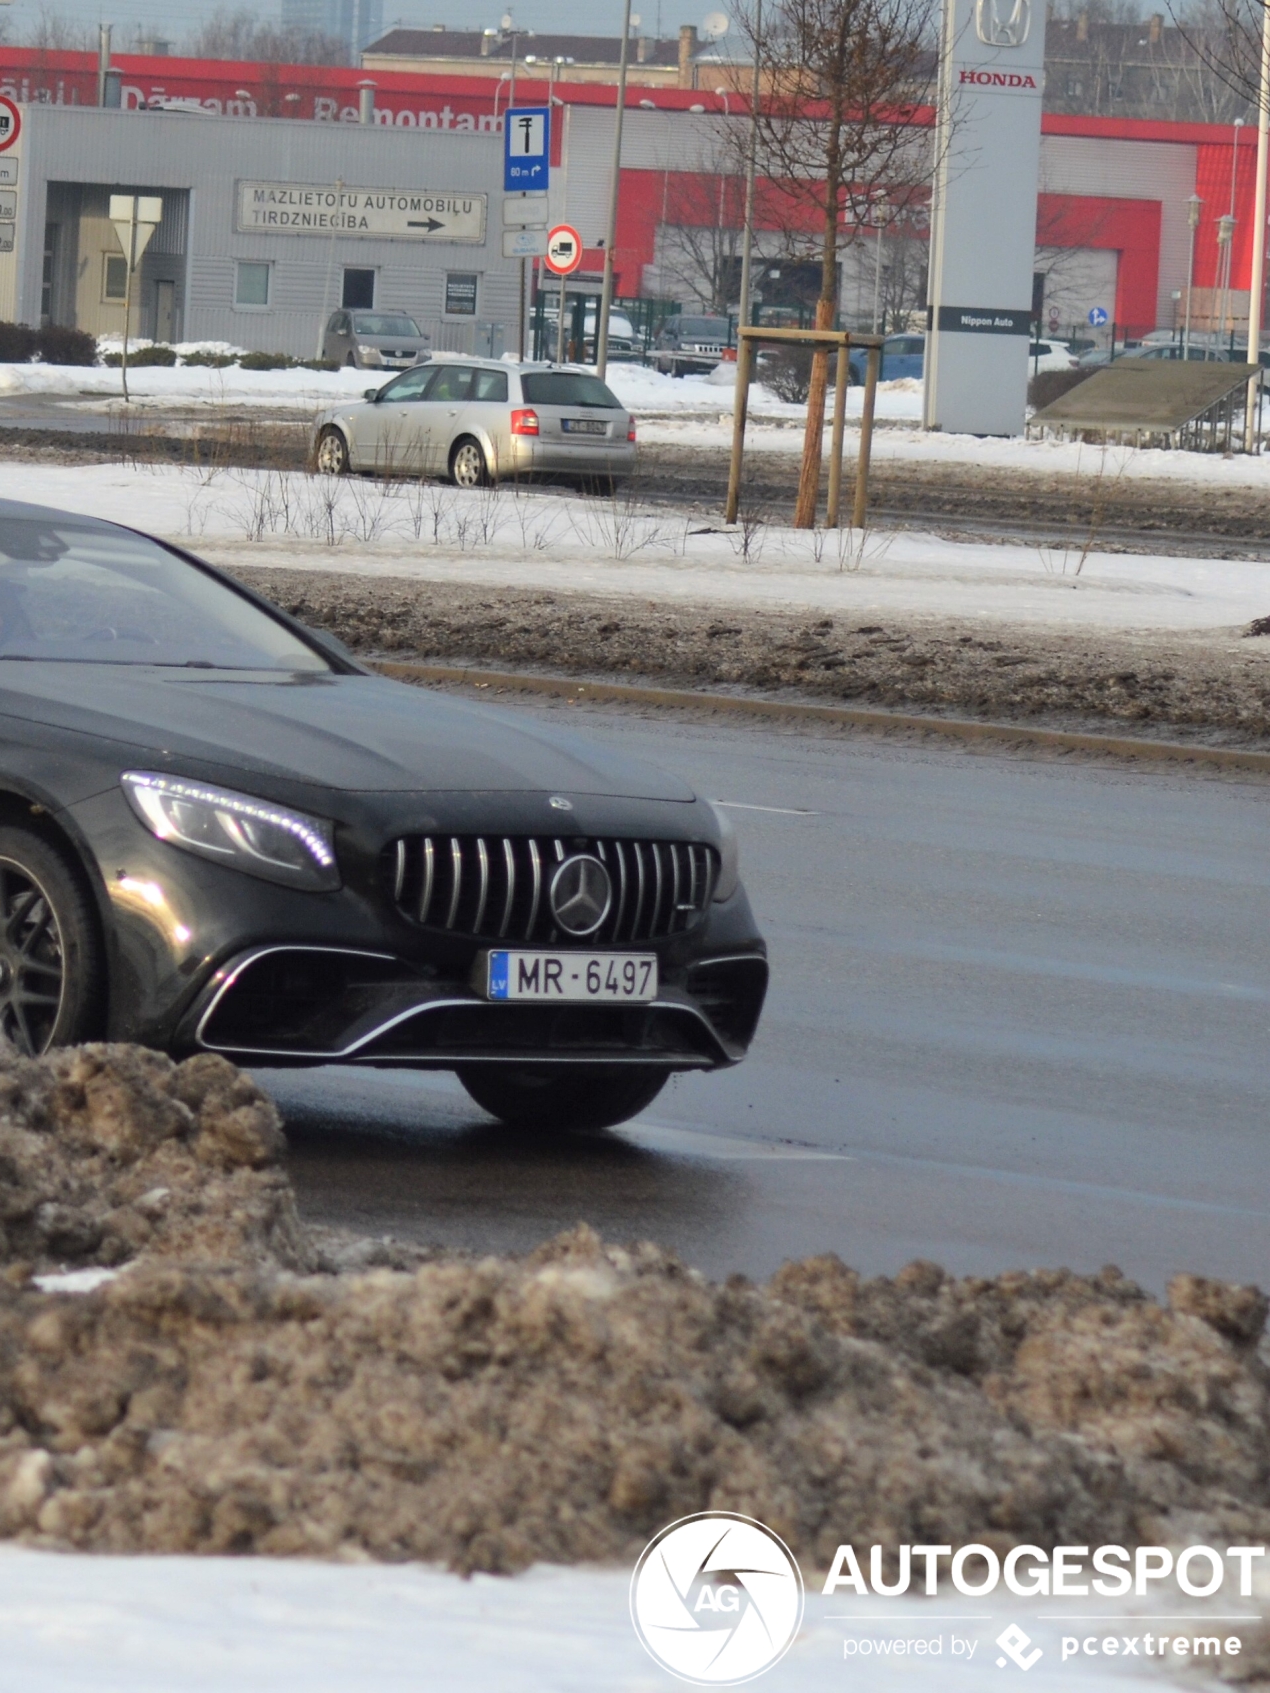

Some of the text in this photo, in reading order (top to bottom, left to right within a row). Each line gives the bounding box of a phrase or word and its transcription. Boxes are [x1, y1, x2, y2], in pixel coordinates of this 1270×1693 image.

[959, 71, 1037, 89] HONDA
[120, 85, 257, 117] Dāam
[0, 170, 10, 178] m
[253, 189, 472, 216] MAZLIETOTU AUTOMOBIĻU
[253, 210, 369, 229] TIRDZNIECĪBA
[961, 315, 1014, 327] Nippon Auto
[492, 958, 652, 996] LV MR-6497
